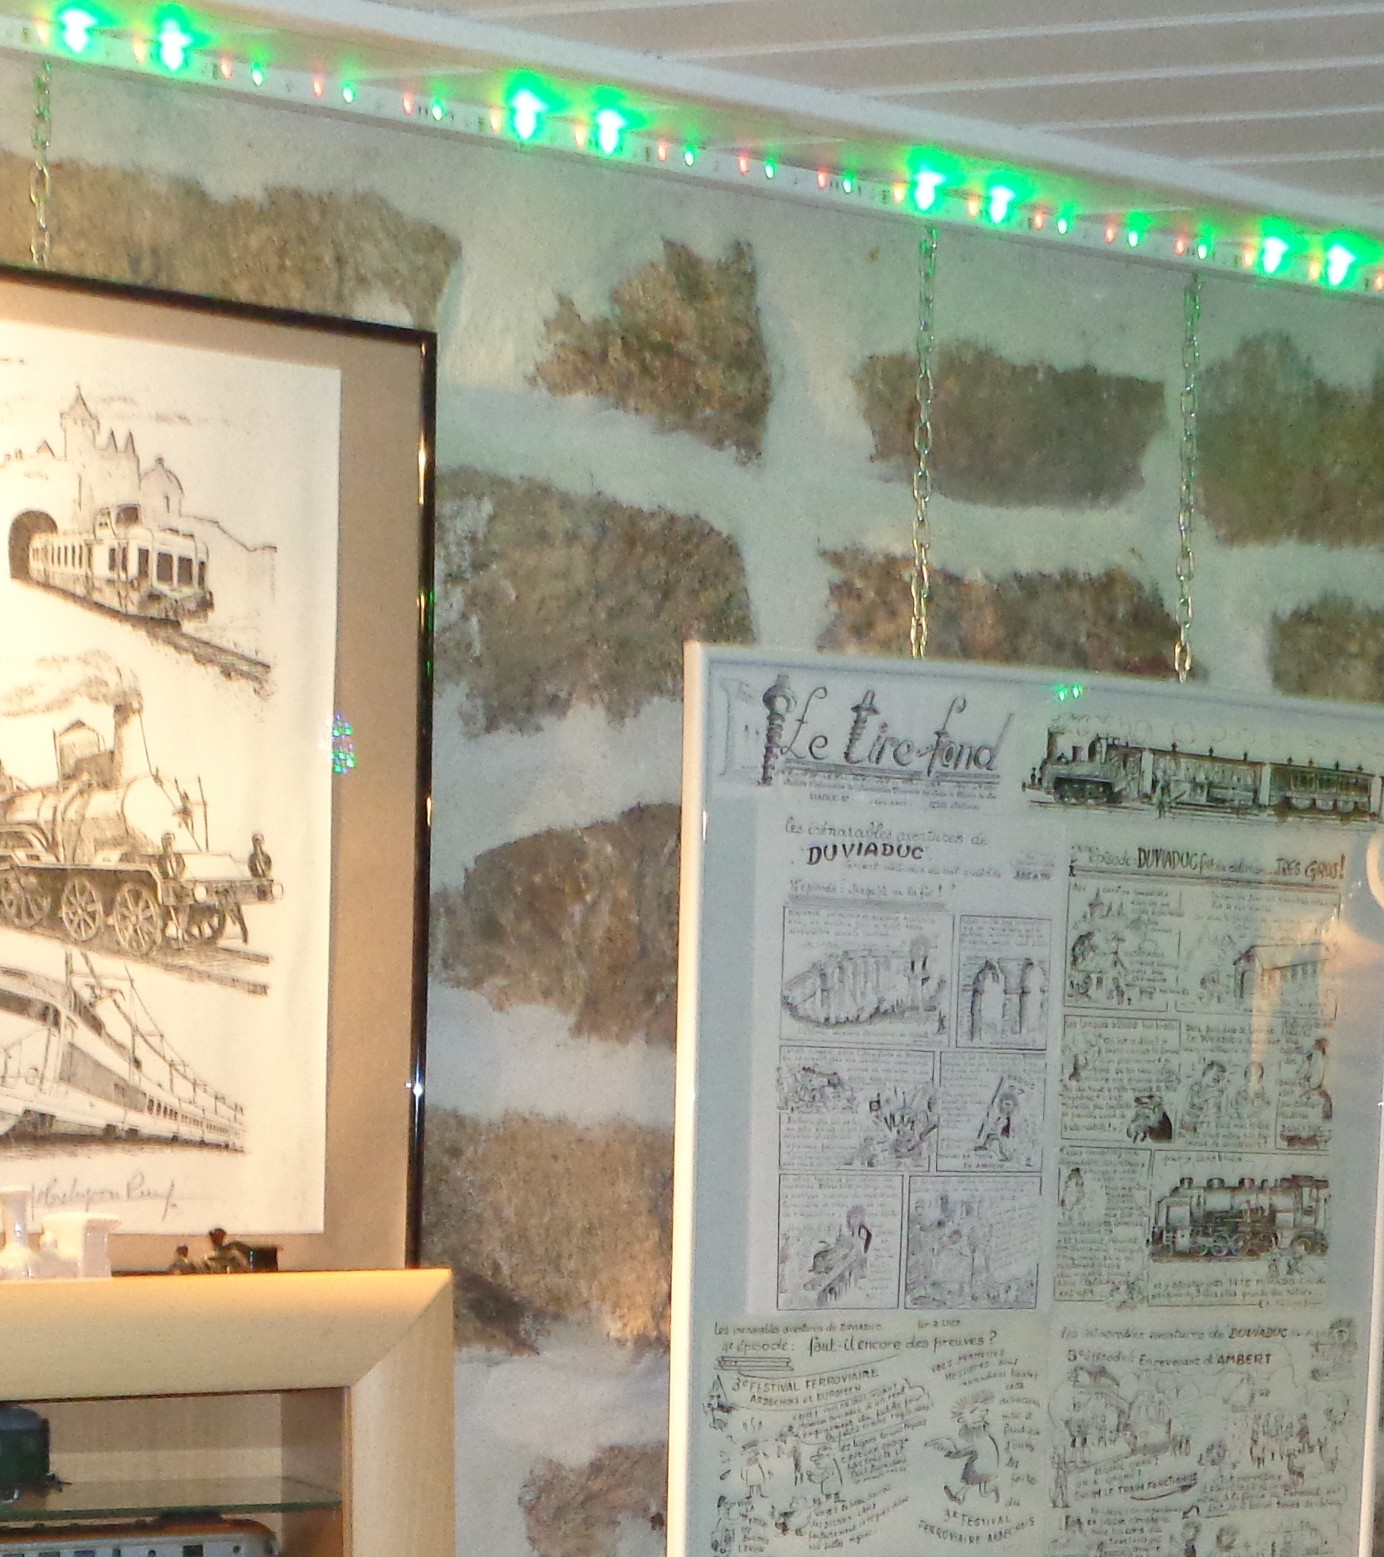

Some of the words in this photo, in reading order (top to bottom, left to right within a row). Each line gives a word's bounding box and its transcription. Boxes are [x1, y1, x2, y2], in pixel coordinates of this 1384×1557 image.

[779, 685, 829, 761] Le
[857, 1339, 902, 1351] encore
[905, 1333, 930, 1349] des
[749, 1379, 800, 1393] FESTIVAL
[804, 1368, 880, 1390] FERROVIAIRE
